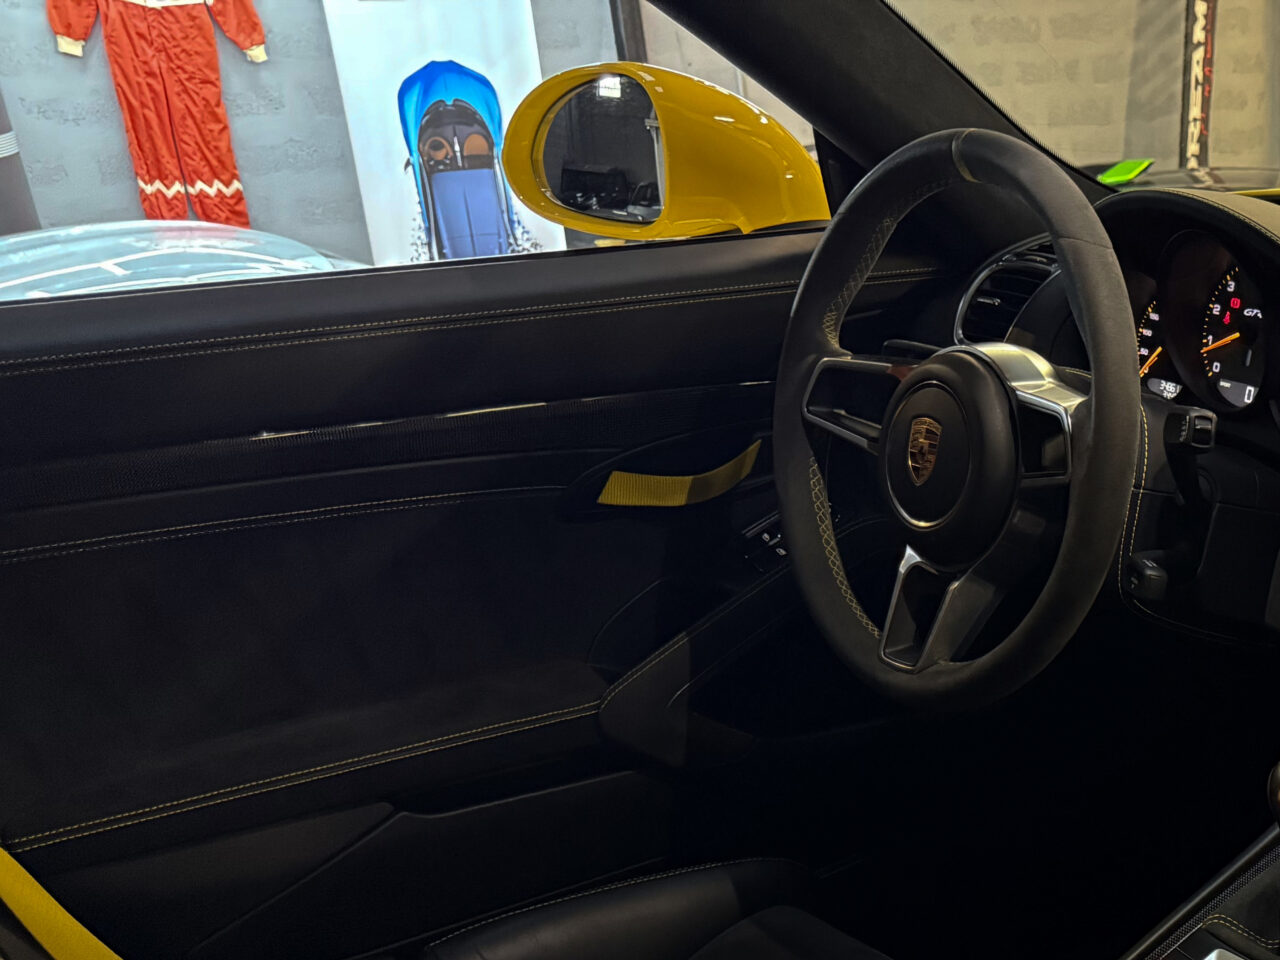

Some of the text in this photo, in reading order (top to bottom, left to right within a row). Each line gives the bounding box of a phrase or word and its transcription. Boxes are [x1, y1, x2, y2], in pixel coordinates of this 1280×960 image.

[1227, 281, 1235, 292] 3
[1212, 304, 1221, 315] 2
[1212, 361, 1221, 373] 0
